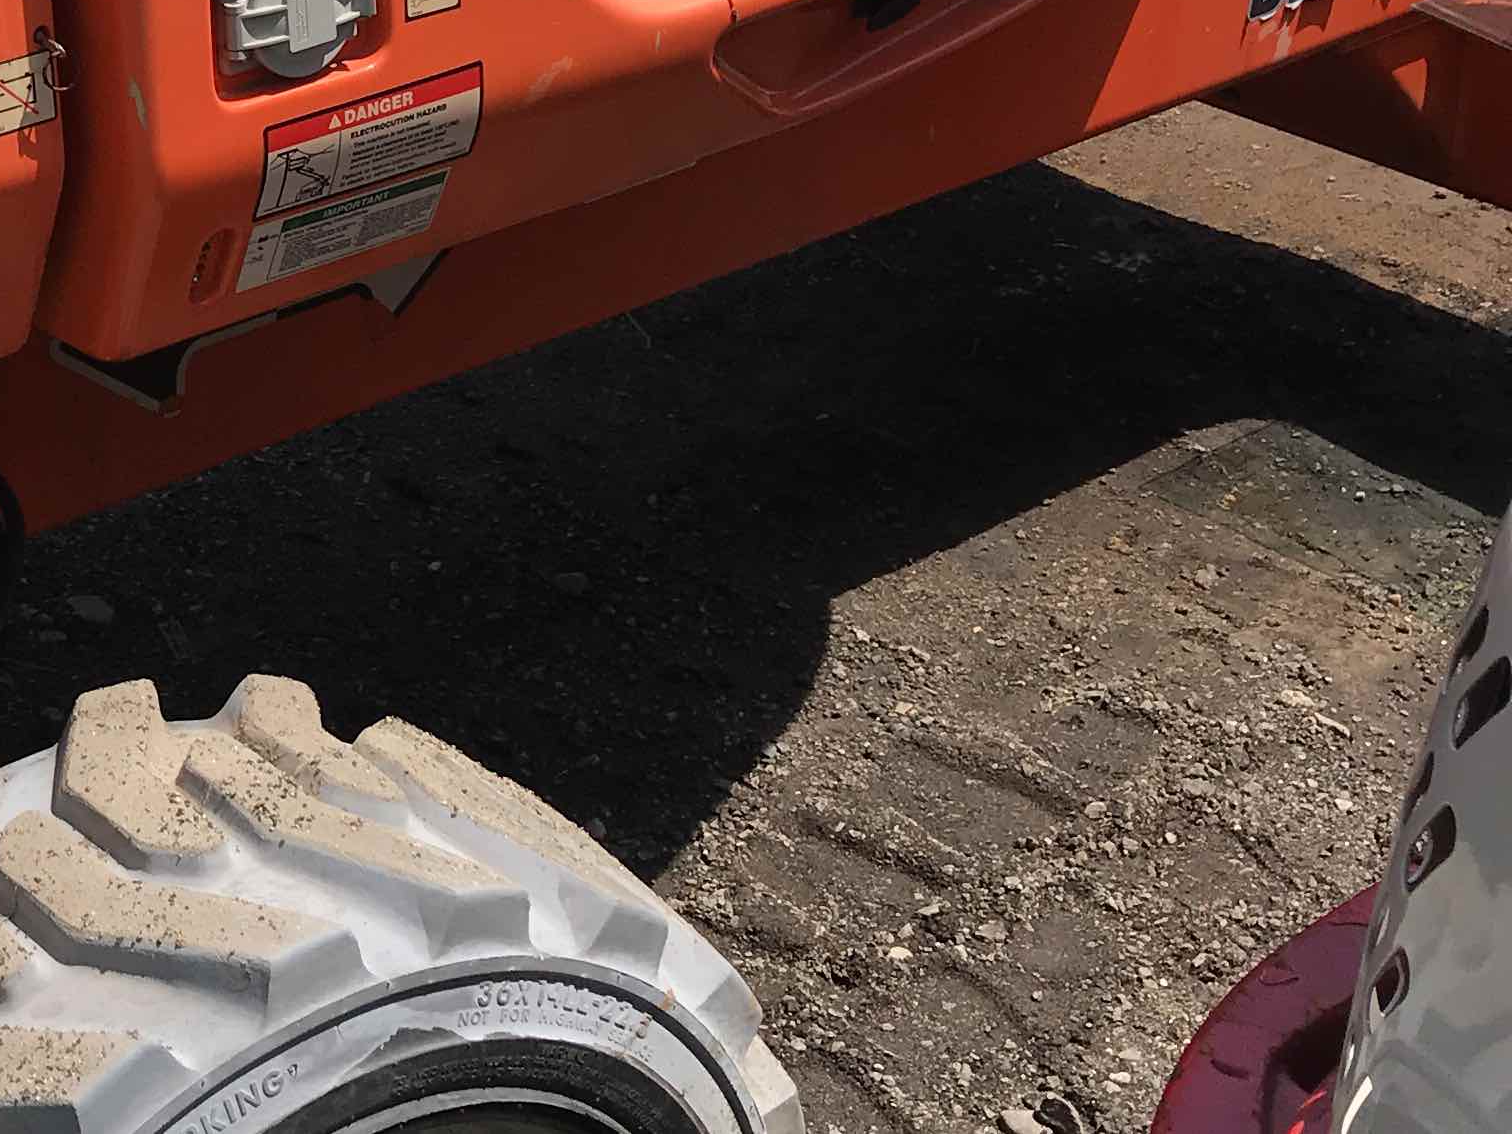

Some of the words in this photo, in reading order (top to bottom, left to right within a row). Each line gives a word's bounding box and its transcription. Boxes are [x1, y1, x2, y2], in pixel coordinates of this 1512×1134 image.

[344, 91, 414, 125] DANGER
[350, 113, 415, 139] ELECTROCUTION
[416, 103, 447, 119] HAZARD
[321, 191, 391, 218] IMPORTANT
[457, 1009, 490, 1028] NOT
[499, 1008, 531, 1024] FOR
